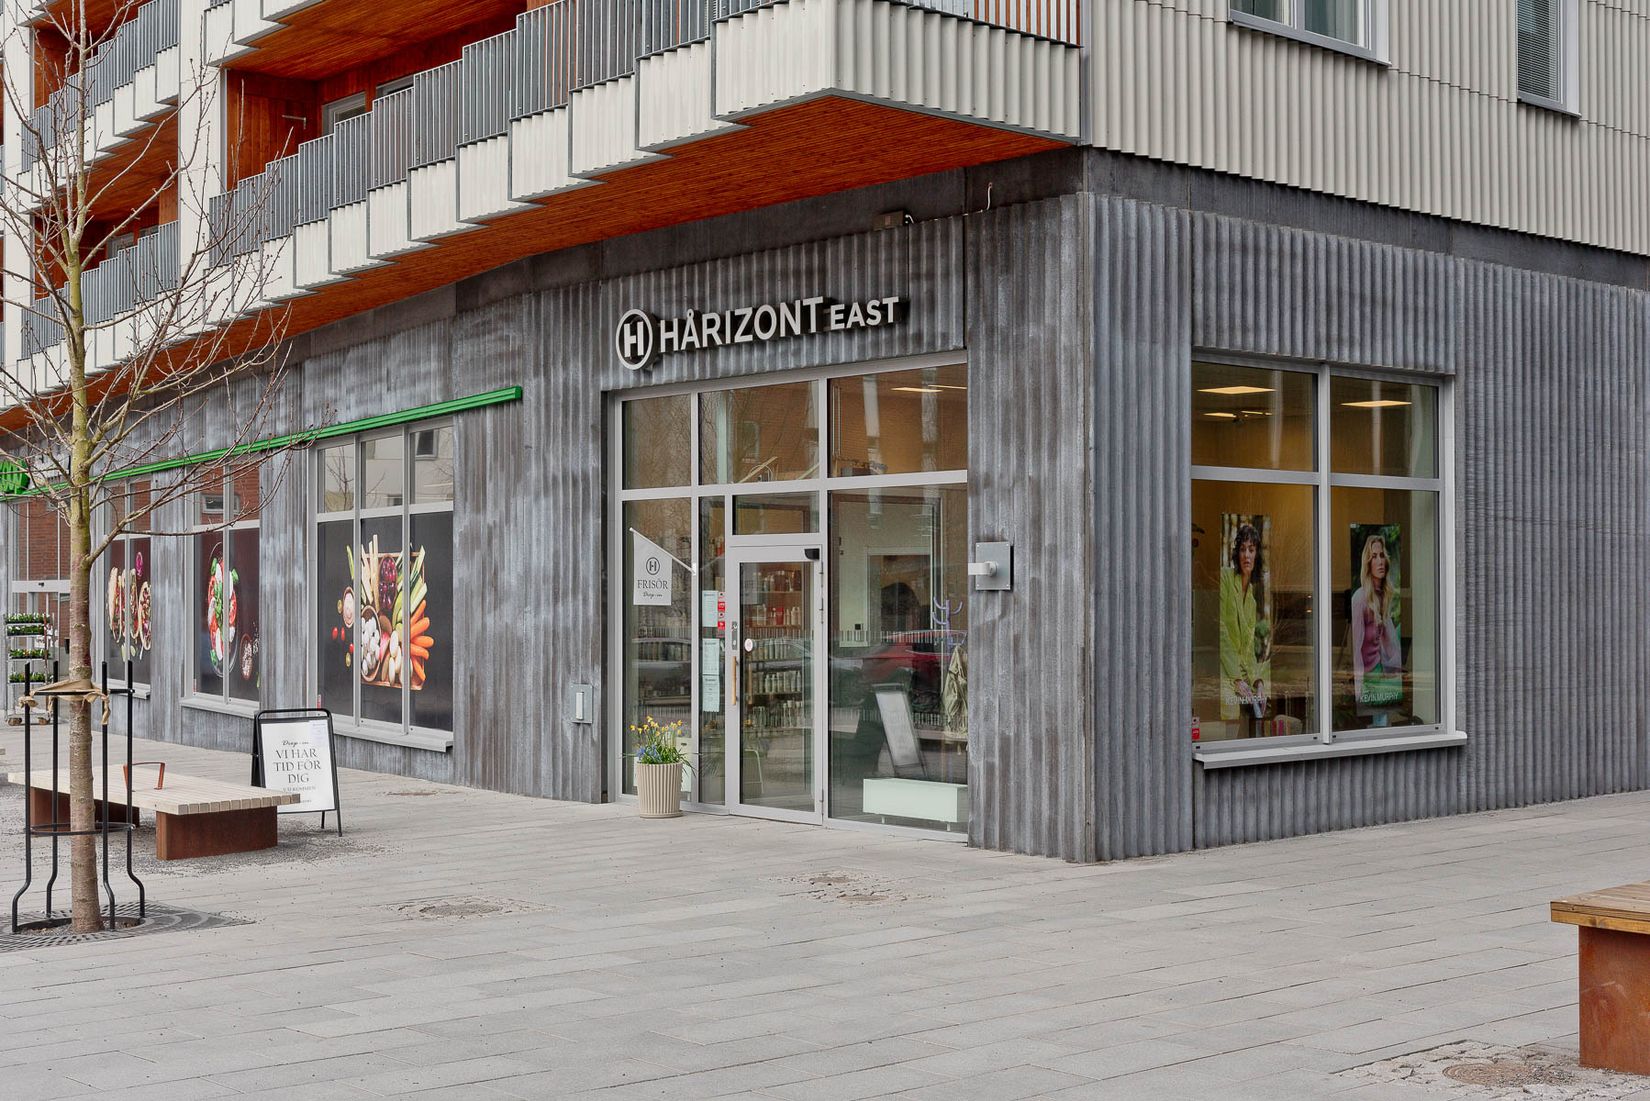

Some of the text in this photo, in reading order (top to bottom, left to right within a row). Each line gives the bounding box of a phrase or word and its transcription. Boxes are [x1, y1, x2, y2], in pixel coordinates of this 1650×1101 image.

[659, 297, 900, 353] HÅRIZONT EAST
[275, 748, 318, 759] VI HAR
[272, 761, 295, 772] TID
[287, 773, 310, 784] DIG
